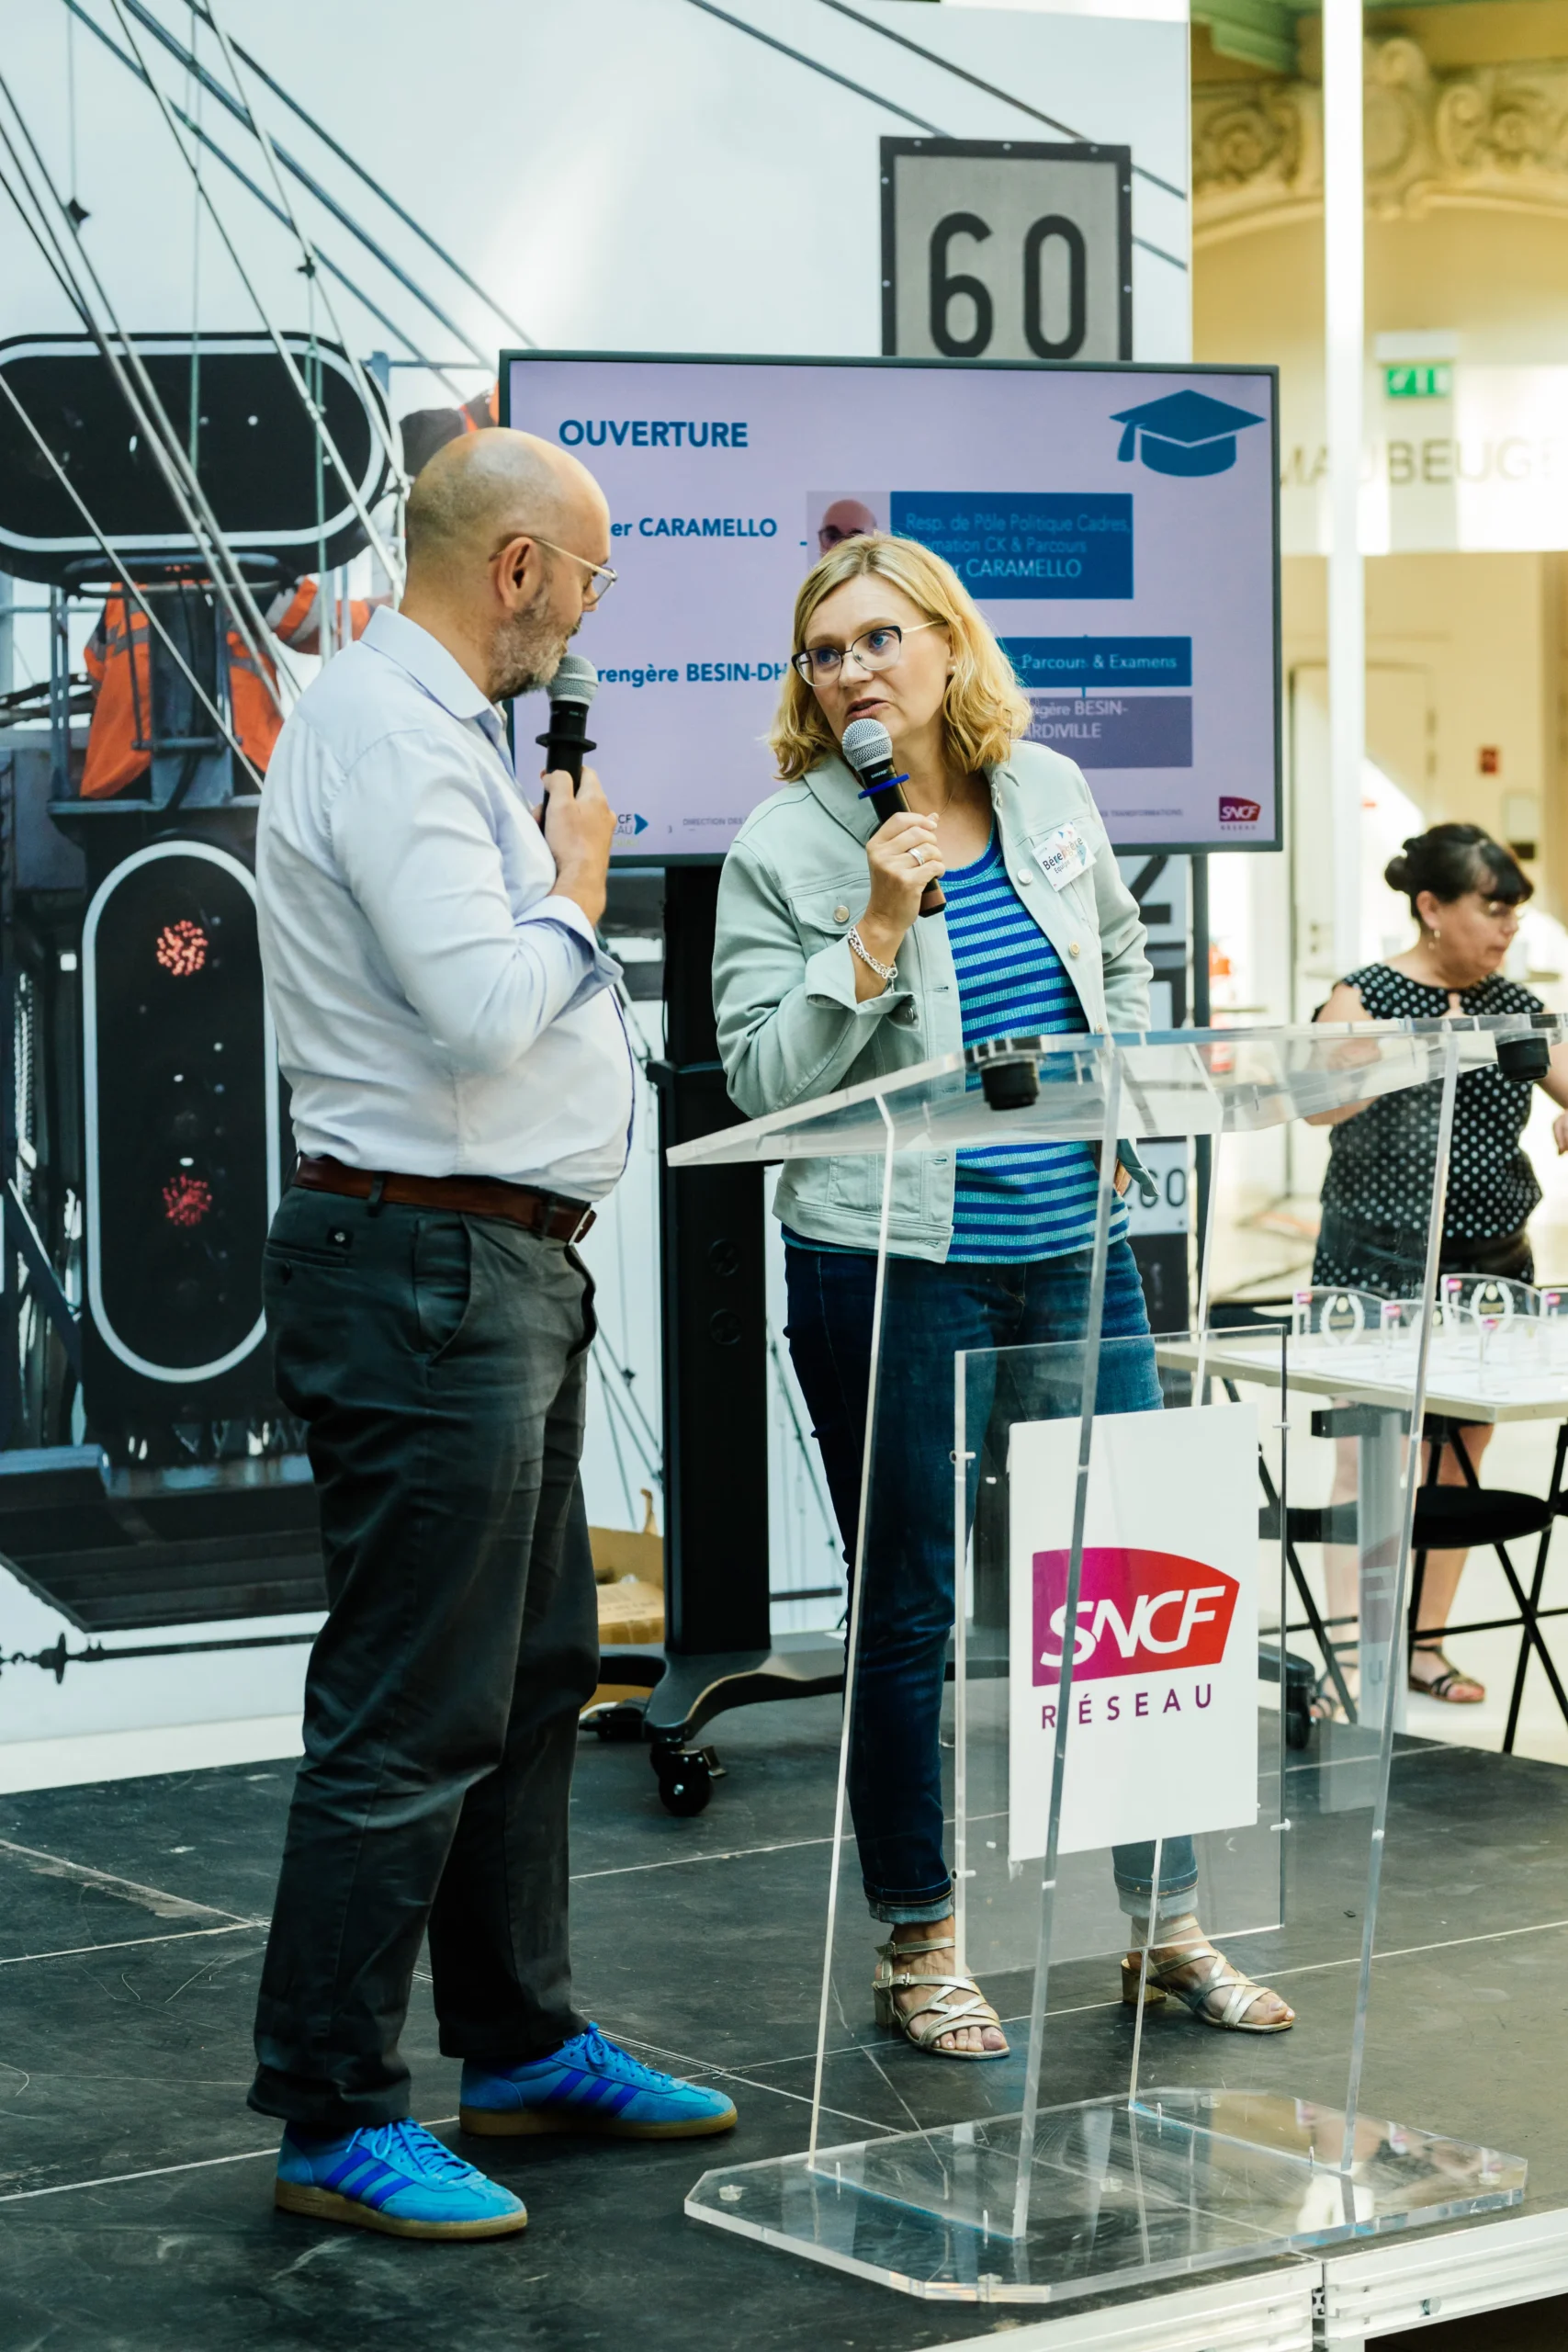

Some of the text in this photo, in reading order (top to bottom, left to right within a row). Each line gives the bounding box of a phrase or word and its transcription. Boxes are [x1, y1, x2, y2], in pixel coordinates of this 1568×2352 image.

[930, 211, 1087, 359] 60
[558, 419, 749, 448] OUVERTURE
[638, 517, 778, 537] CARAMELLO
[906, 513, 946, 534] Resp.
[951, 513, 970, 531] de
[1010, 513, 1074, 535] Politique
[1011, 537, 1021, 552] &
[1027, 537, 1089, 553] Parcours
[966, 559, 1083, 578] CARAMELLO
[1092, 654, 1105, 669] &
[1110, 653, 1178, 669] Examens
[597, 664, 680, 688] rengère
[1075, 700, 1129, 717] BESIN-
[1221, 805, 1258, 820] SNCF
[1040, 1586, 1226, 1668] SNCF
[1042, 1683, 1212, 1730] RÉSEAU
